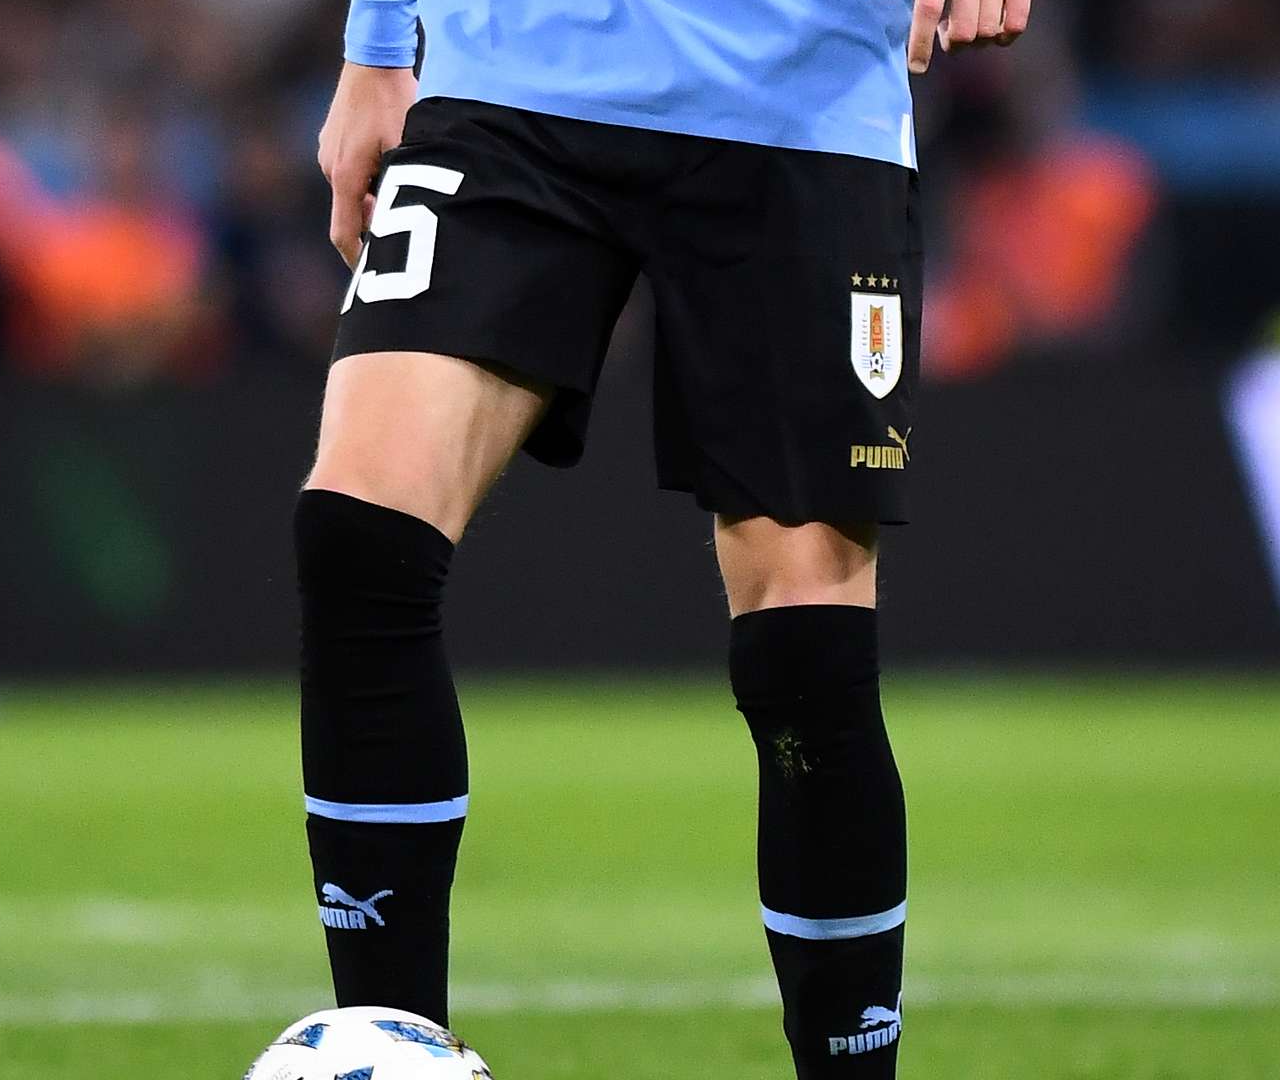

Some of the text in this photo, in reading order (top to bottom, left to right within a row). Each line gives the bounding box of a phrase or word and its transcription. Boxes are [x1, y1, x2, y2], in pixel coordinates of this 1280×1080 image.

[872, 311, 883, 348] AUF
[850, 445, 904, 469] PUMA
[319, 906, 367, 929] UMA
[828, 1022, 898, 1056] PUMA
